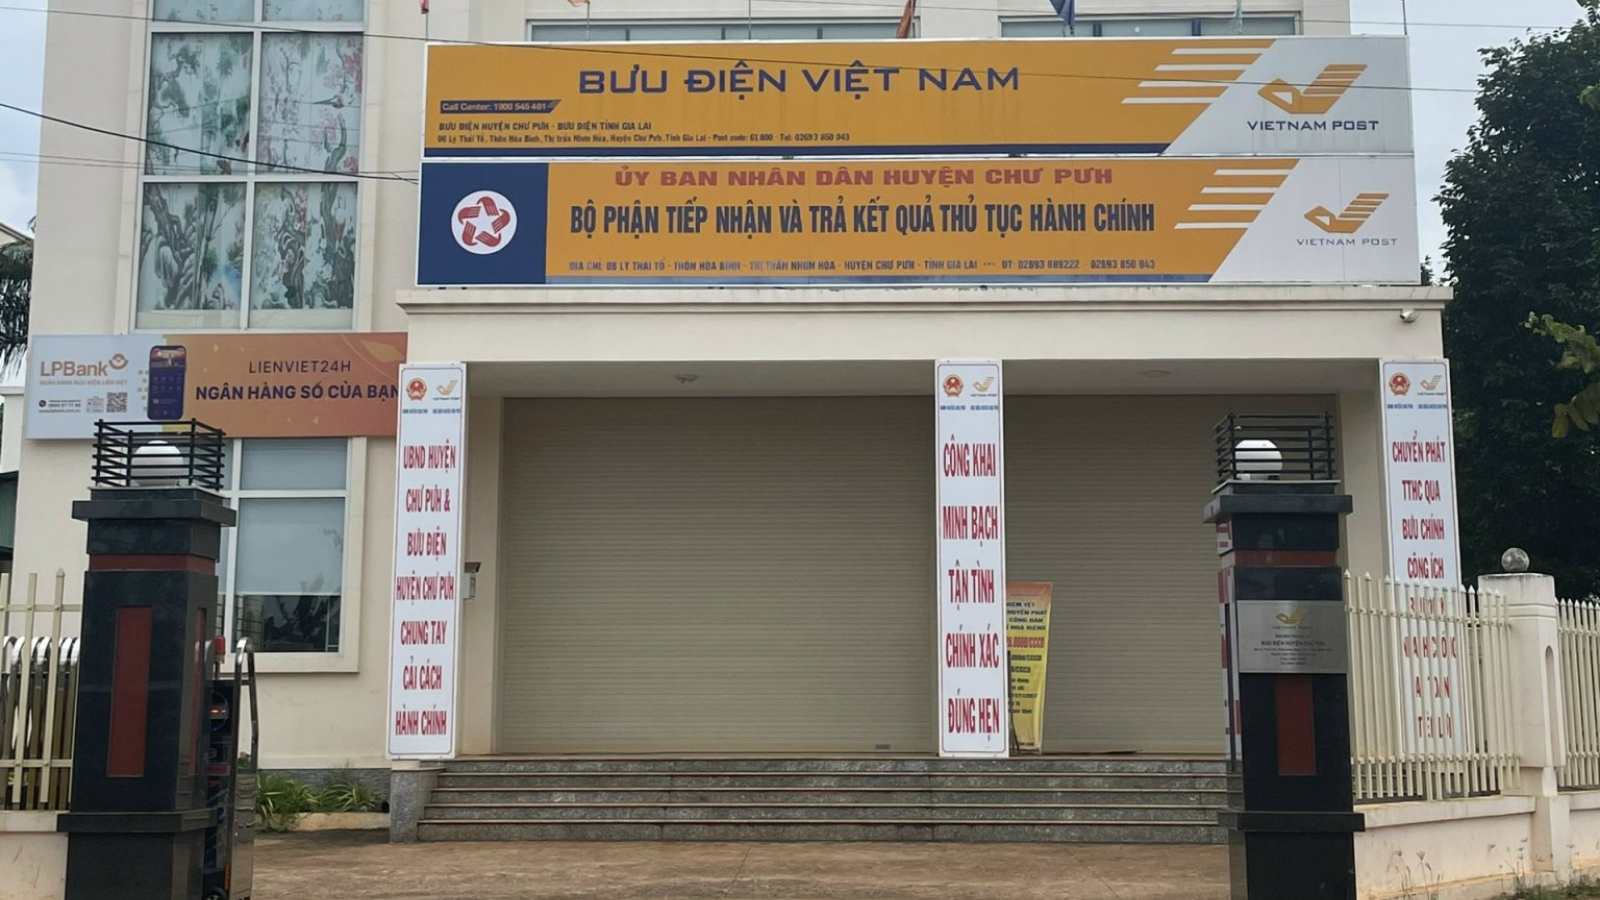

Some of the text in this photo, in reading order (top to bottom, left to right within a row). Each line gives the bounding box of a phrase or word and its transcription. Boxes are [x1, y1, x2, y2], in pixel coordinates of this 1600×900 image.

[578, 60, 1019, 100] BƯU ĐIỆN VIỆT NAM
[442, 103, 459, 111] Call
[622, 121, 635, 130] GIA
[637, 121, 652, 130] LAI
[1247, 120, 1379, 131] VIETNAM POST
[615, 166, 1112, 188] ỦY BAN NHÂN DÂN HUYỆN CHƯ PƯH
[570, 195, 1155, 239] BỘ PHẬN TIẾP NHẬN VÀ TRẢ KẾT QUẢ THỦ TỤC HÀNH CHÍNH
[1296, 238, 1398, 246] VIETNAM POST
[40, 360, 108, 377] LPBank
[249, 360, 351, 373] LIENVIET24H
[196, 383, 243, 400] NGÂN
[248, 382, 296, 399] HÀNG
[300, 381, 323, 399] SỐ
[328, 380, 363, 399] CỦA
[403, 439, 457, 473] UBND HUYỆN
[943, 434, 996, 477] CÔNG KHAI
[1392, 430, 1446, 463] CHUYỂN PHÁT
[405, 484, 424, 512] CHƯ
[443, 488, 451, 512] &
[1402, 480, 1441, 505] TTHC QUA
[943, 505, 998, 547] MINH BẠCH
[1420, 513, 1445, 541] CHÍNH
[426, 525, 446, 560] ĐIỆN
[1407, 552, 1444, 579] CÔNG ÍCH
[396, 570, 421, 605] HUYỆN
[422, 572, 439, 601] CHƯ
[948, 560, 994, 611] TẬN TÌNH
[401, 620, 447, 645] CHUNG TAY
[946, 624, 999, 668] CHÍNH XÁC
[403, 656, 442, 690] CẢI CÁCH
[395, 704, 447, 735] HÀNH CHÍNH
[948, 688, 999, 741] ĐÚNG HẸN
